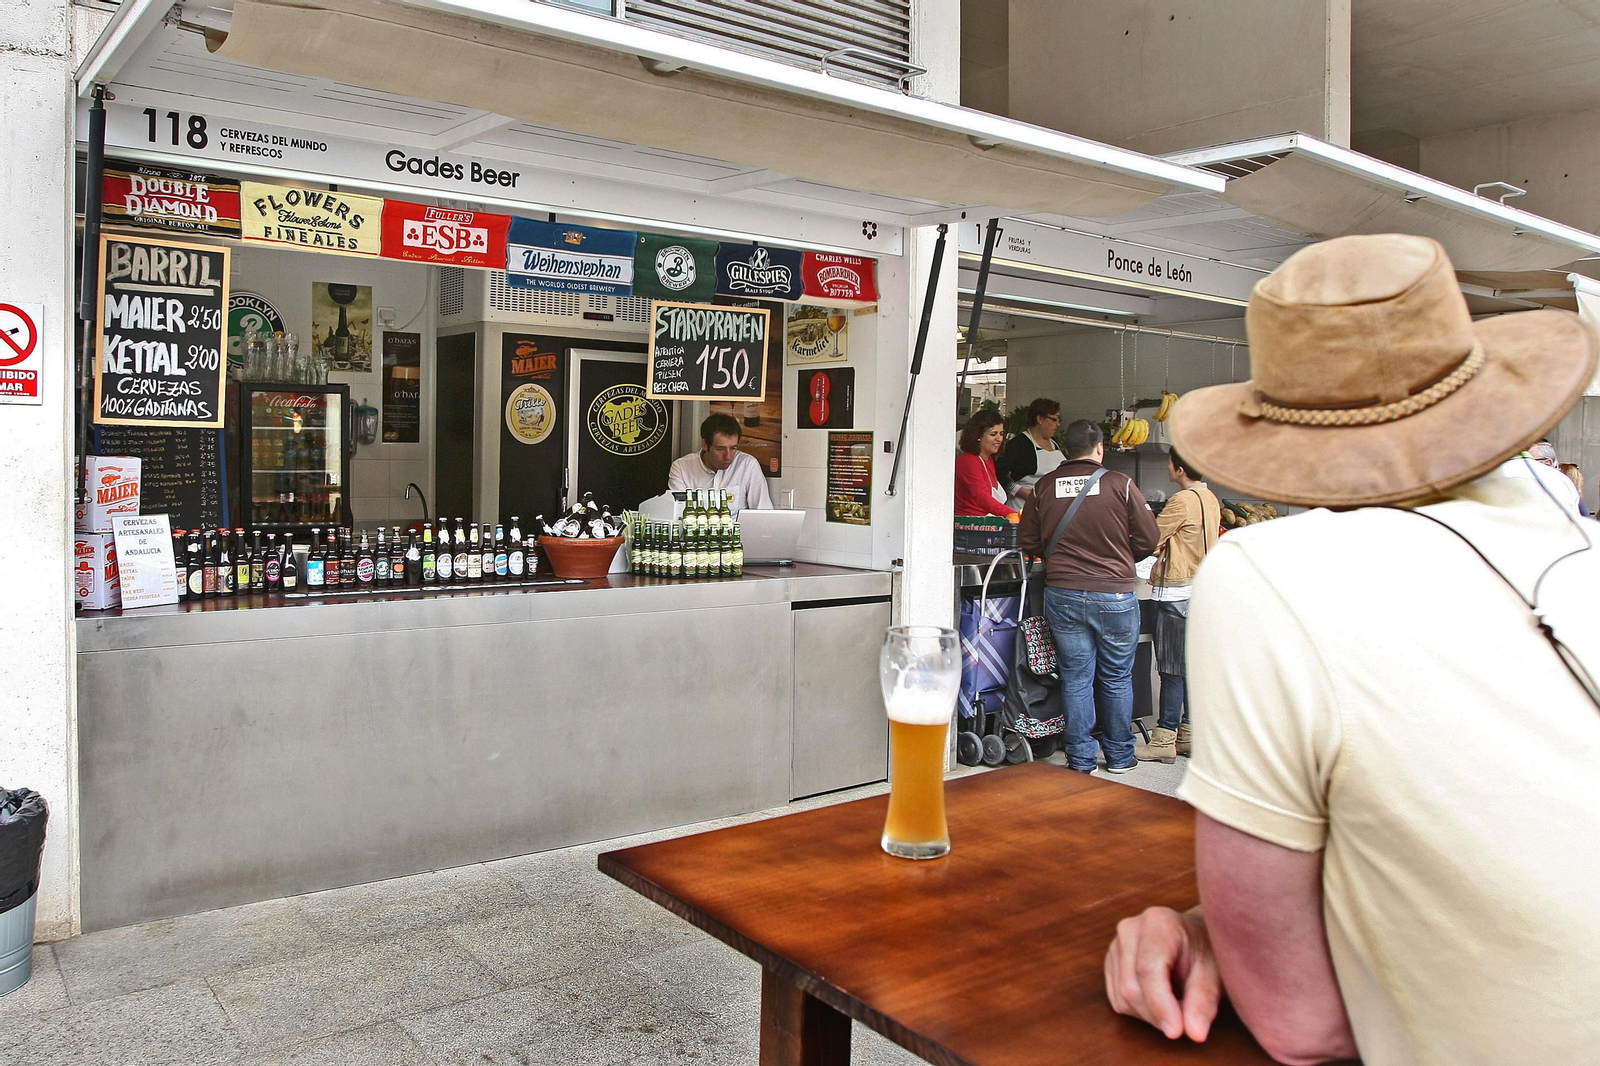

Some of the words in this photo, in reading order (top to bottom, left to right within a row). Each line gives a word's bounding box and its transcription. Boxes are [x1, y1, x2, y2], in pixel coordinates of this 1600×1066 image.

[143, 107, 209, 150] 118
[220, 127, 269, 144] CERVEZAS
[272, 135, 288, 147] DEL
[290, 138, 328, 152] MUNDO
[220, 141, 226, 151] Y
[229, 143, 283, 159] REFRESCOS
[385, 149, 464, 181] Gades
[470, 161, 520, 188] Beer
[128, 174, 210, 203] DOUBLE
[124, 194, 218, 223] DIAMOND
[253, 189, 365, 229] FLOWERS
[429, 208, 472, 223] FULLER'S
[264, 226, 308, 244] FINE
[313, 233, 358, 250] ALES
[421, 224, 470, 250] ESB
[976, 223, 1004, 249] 17
[1008, 236, 1025, 245] FRUTAS
[815, 253, 842, 263] CHARLES
[843, 256, 862, 265] WELLS
[1008, 244, 1031, 254] VERDURAS
[106, 242, 221, 287] BARRIL
[522, 249, 621, 280] Weihenstephan
[1107, 249, 1143, 275] Ponce
[1147, 257, 1162, 277] de
[1166, 261, 1192, 283] León
[526, 278, 537, 286] THE
[567, 282, 588, 291] OLDEST
[590, 284, 615, 293] BREWERY
[829, 288, 854, 298] BITTER
[105, 294, 186, 333] MAIER
[187, 305, 221, 331] 2'50
[655, 306, 764, 343] STAROPRAMEN
[102, 334, 187, 376] KETTAL
[184, 344, 219, 371] 2'00
[511, 354, 557, 375] MAIER
[695, 344, 750, 392] 1'50
[117, 376, 202, 397] CERVEZAS
[593, 387, 624, 412] CERVEZAS
[601, 401, 647, 427] GADES
[611, 417, 652, 439] BEER
[97, 482, 139, 504] MAIER
[118, 527, 165, 537] ARTESANALES
[122, 518, 157, 526] CERVEZAS
